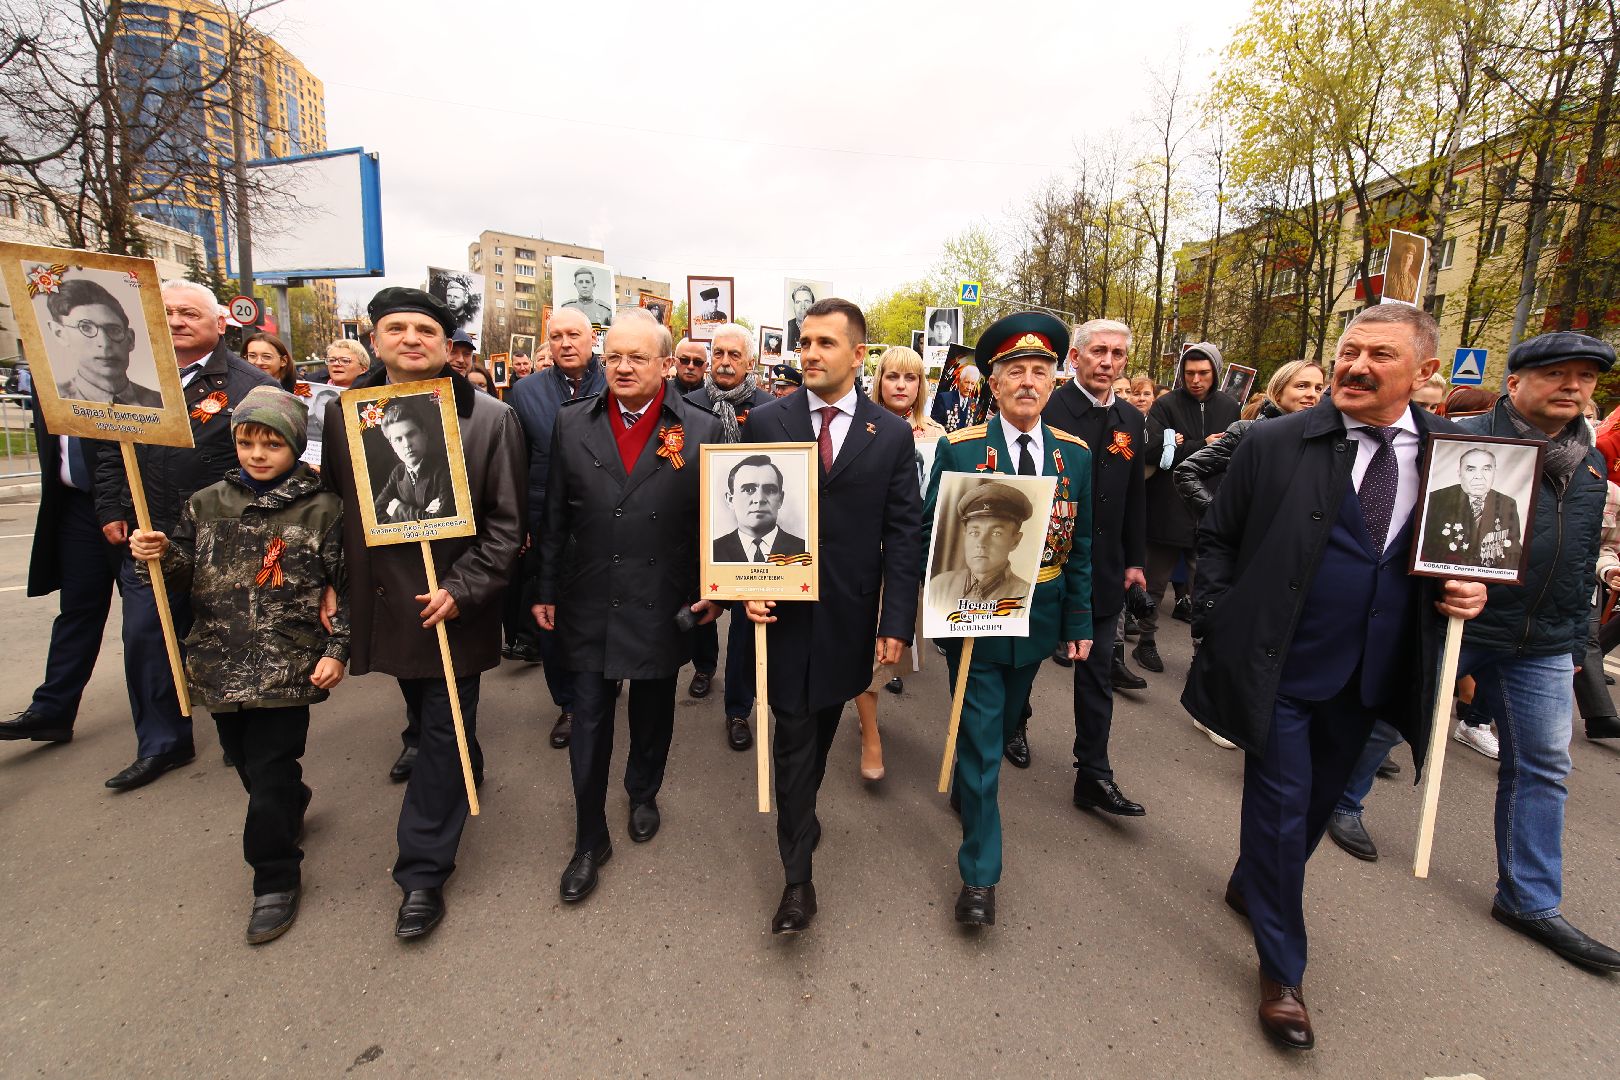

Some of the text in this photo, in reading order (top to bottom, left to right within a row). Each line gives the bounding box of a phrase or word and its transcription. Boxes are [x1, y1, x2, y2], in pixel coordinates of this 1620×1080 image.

[236, 304, 252, 317] 20
[72, 404, 161, 424] Бараз Григорий
[1423, 562, 1451, 570] КОВАЛЕВ
[1453, 565, 1475, 573] Сергей
[958, 599, 997, 610] Нечай
[960, 611, 992, 622] Сергей
[950, 623, 1002, 632] Васильевич
